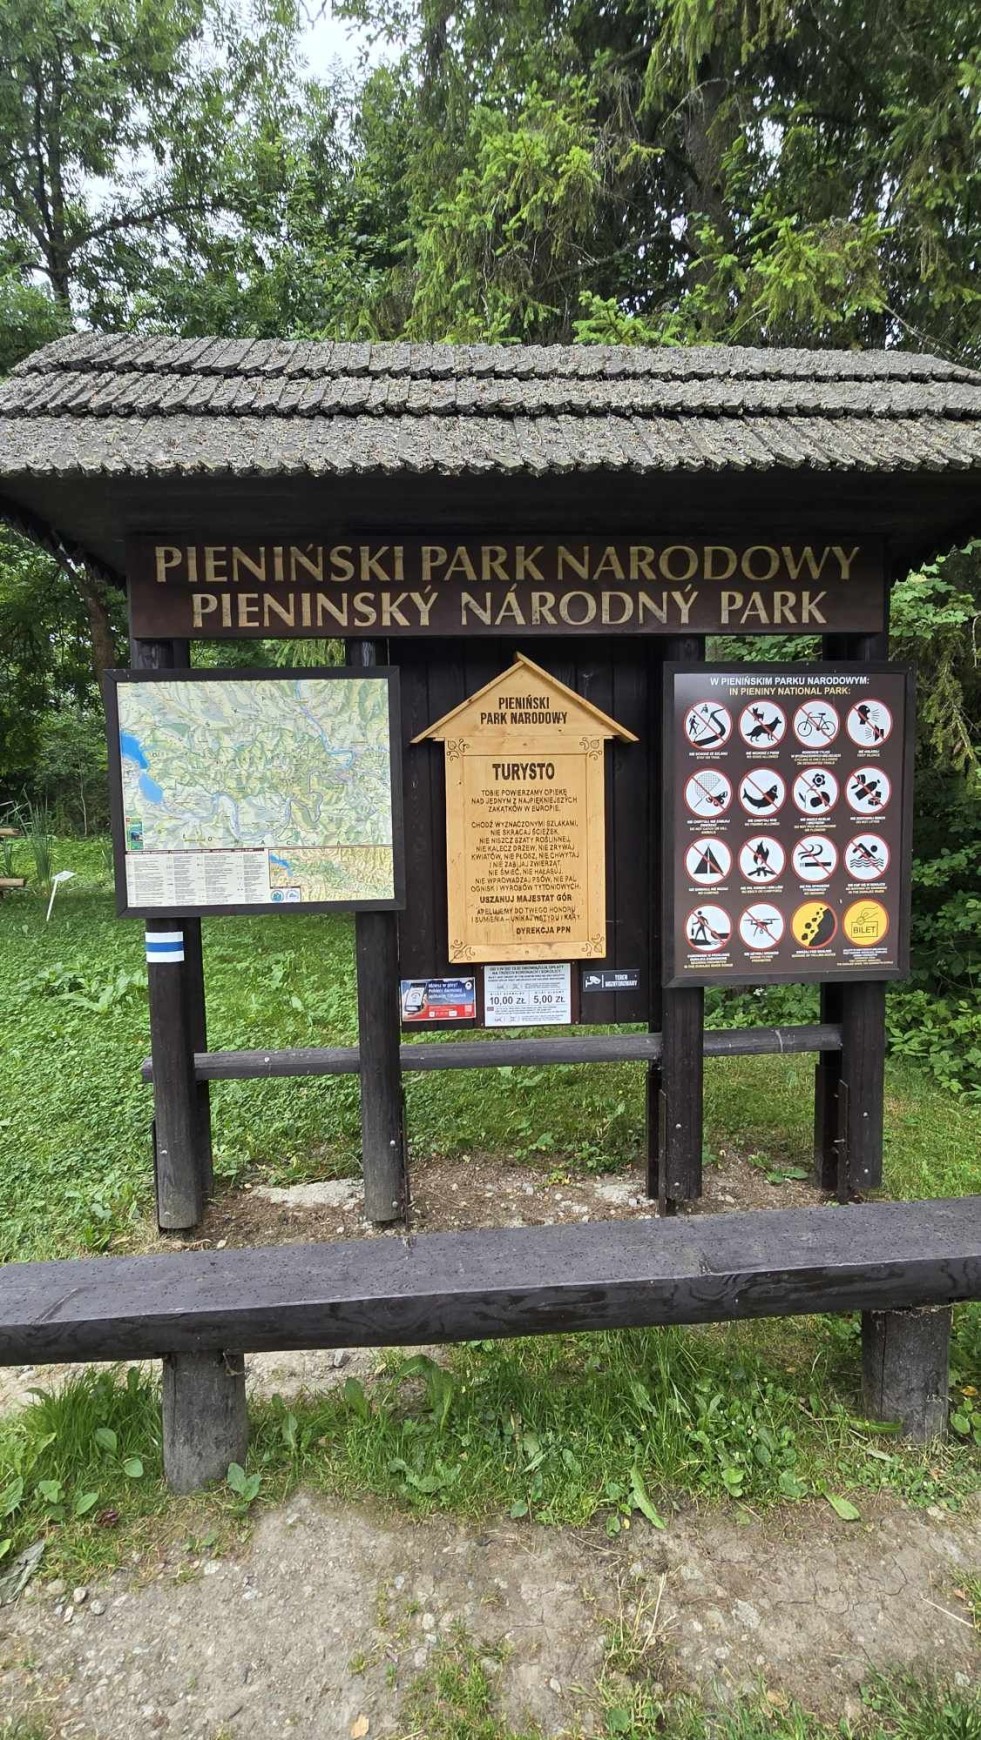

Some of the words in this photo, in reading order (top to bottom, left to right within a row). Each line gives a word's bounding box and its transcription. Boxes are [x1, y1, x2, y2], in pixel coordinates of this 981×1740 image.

[155, 543, 404, 582] PIENIŃSKI
[421, 546, 545, 582] PARK
[557, 546, 860, 580] NARODOWY
[192, 585, 438, 628] PIENINSKÝ
[461, 583, 698, 626] NÁRODNÝ
[720, 591, 828, 624] PARK
[710, 678, 720, 686] W
[721, 676, 772, 686] PIENIŃSKIM
[774, 677, 805, 685] PARKU
[807, 676, 870, 685] NARODOWYM:
[729, 687, 738, 696] IN
[741, 687, 776, 696] PIENINY
[778, 687, 822, 695] NATIONAL
[824, 686, 851, 695] PARK:
[499, 694, 550, 710] PIENIŃSKI
[480, 712, 508, 724] PARK
[510, 712, 568, 725] NARODOWY
[492, 763, 555, 781] TURYSTO
[480, 896, 514, 904] USZANUJ
[516, 894, 554, 903] MAJESTAT
[556, 892, 572, 902] GÓR
[516, 927, 554, 935] DYREKCJA
[556, 926, 571, 934] PPN
[853, 926, 876, 934] BILET
[490, 996, 513, 1006] 10,00
[533, 994, 553, 1004] 5,00
